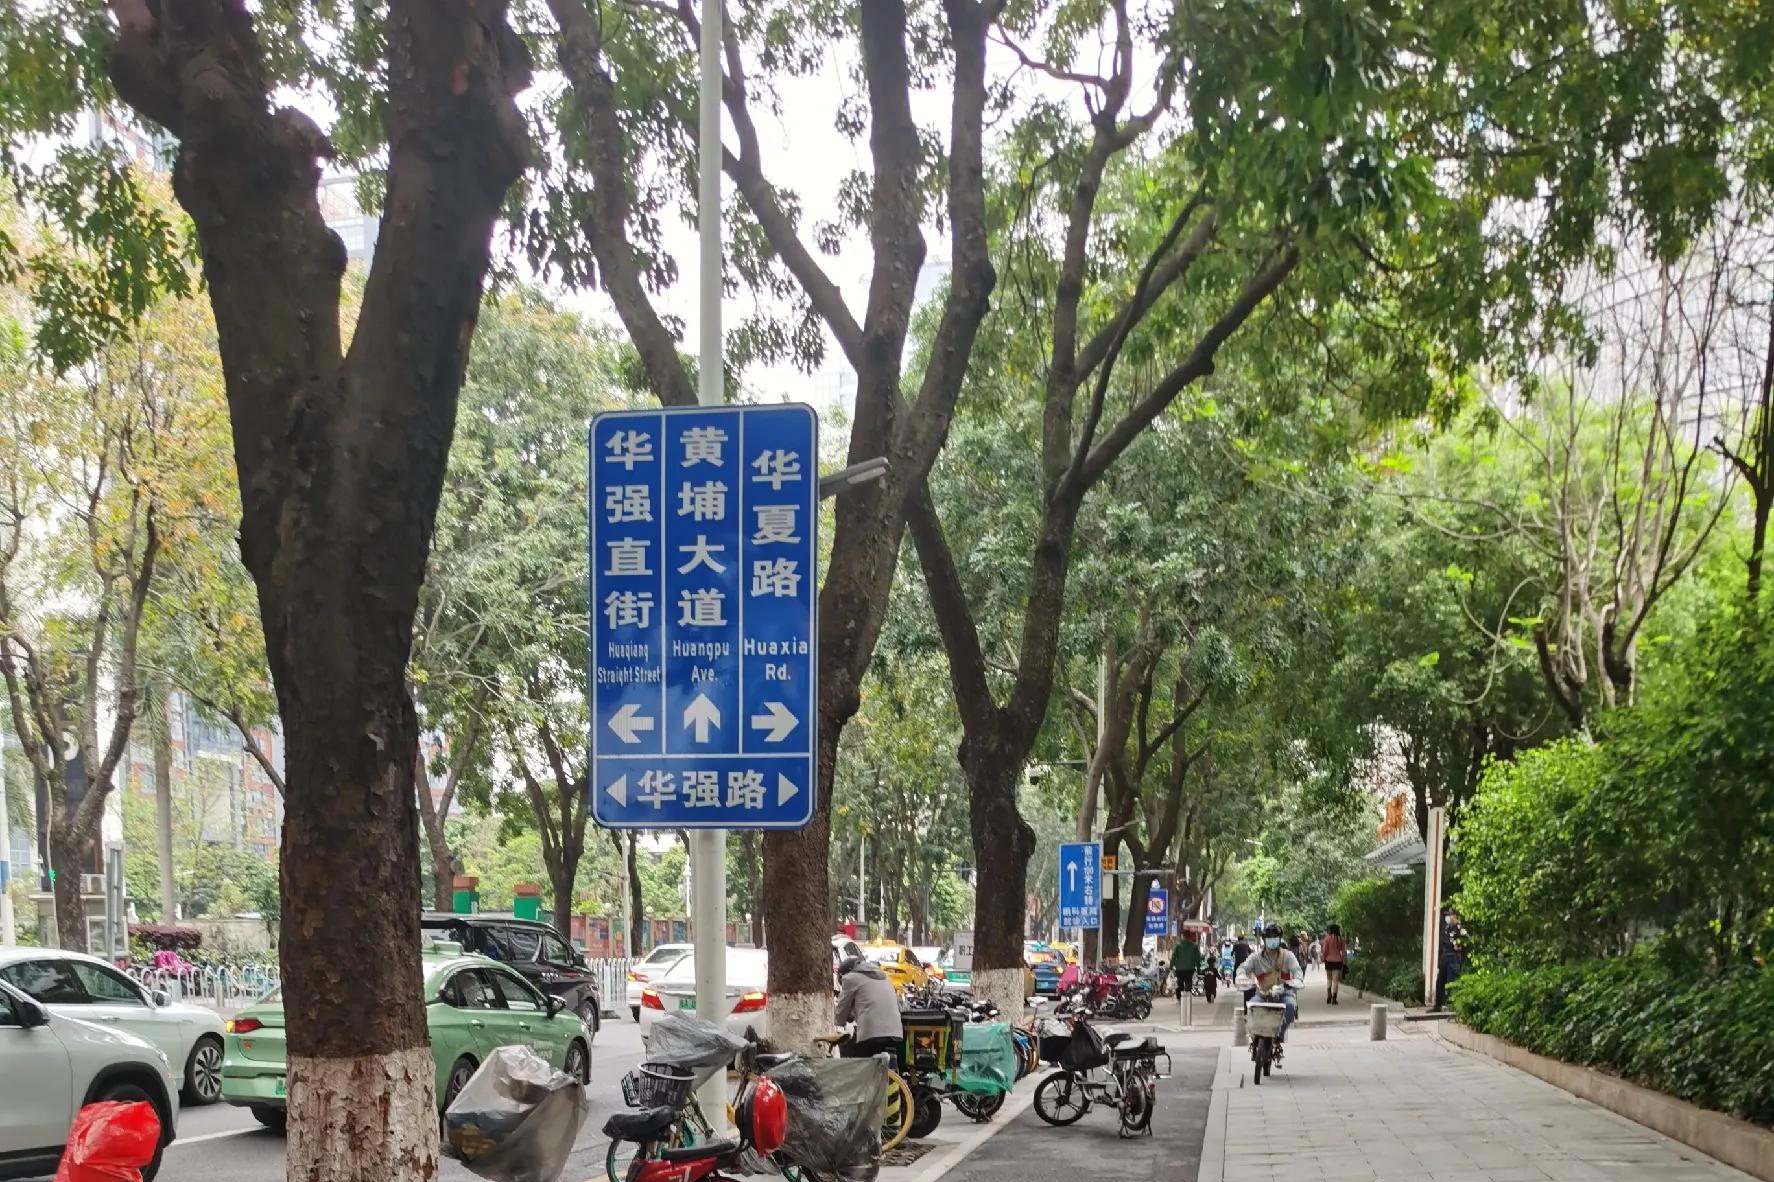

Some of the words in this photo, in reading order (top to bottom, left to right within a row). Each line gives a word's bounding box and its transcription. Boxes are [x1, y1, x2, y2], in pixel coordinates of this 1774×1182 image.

[605, 430, 654, 629] 华强直街
[677, 426, 728, 627] 黄埔大道
[751, 449, 801, 597] 华夏路
[608, 641, 649, 662] Huaqiang
[673, 639, 730, 661] Huangpu
[744, 636, 808, 656] Huaxia
[597, 666, 633, 684] Straight
[634, 666, 660, 683] Street
[691, 665, 719, 682] Ave.
[765, 663, 792, 681] Rd.
[637, 769, 767, 809] 华强路
